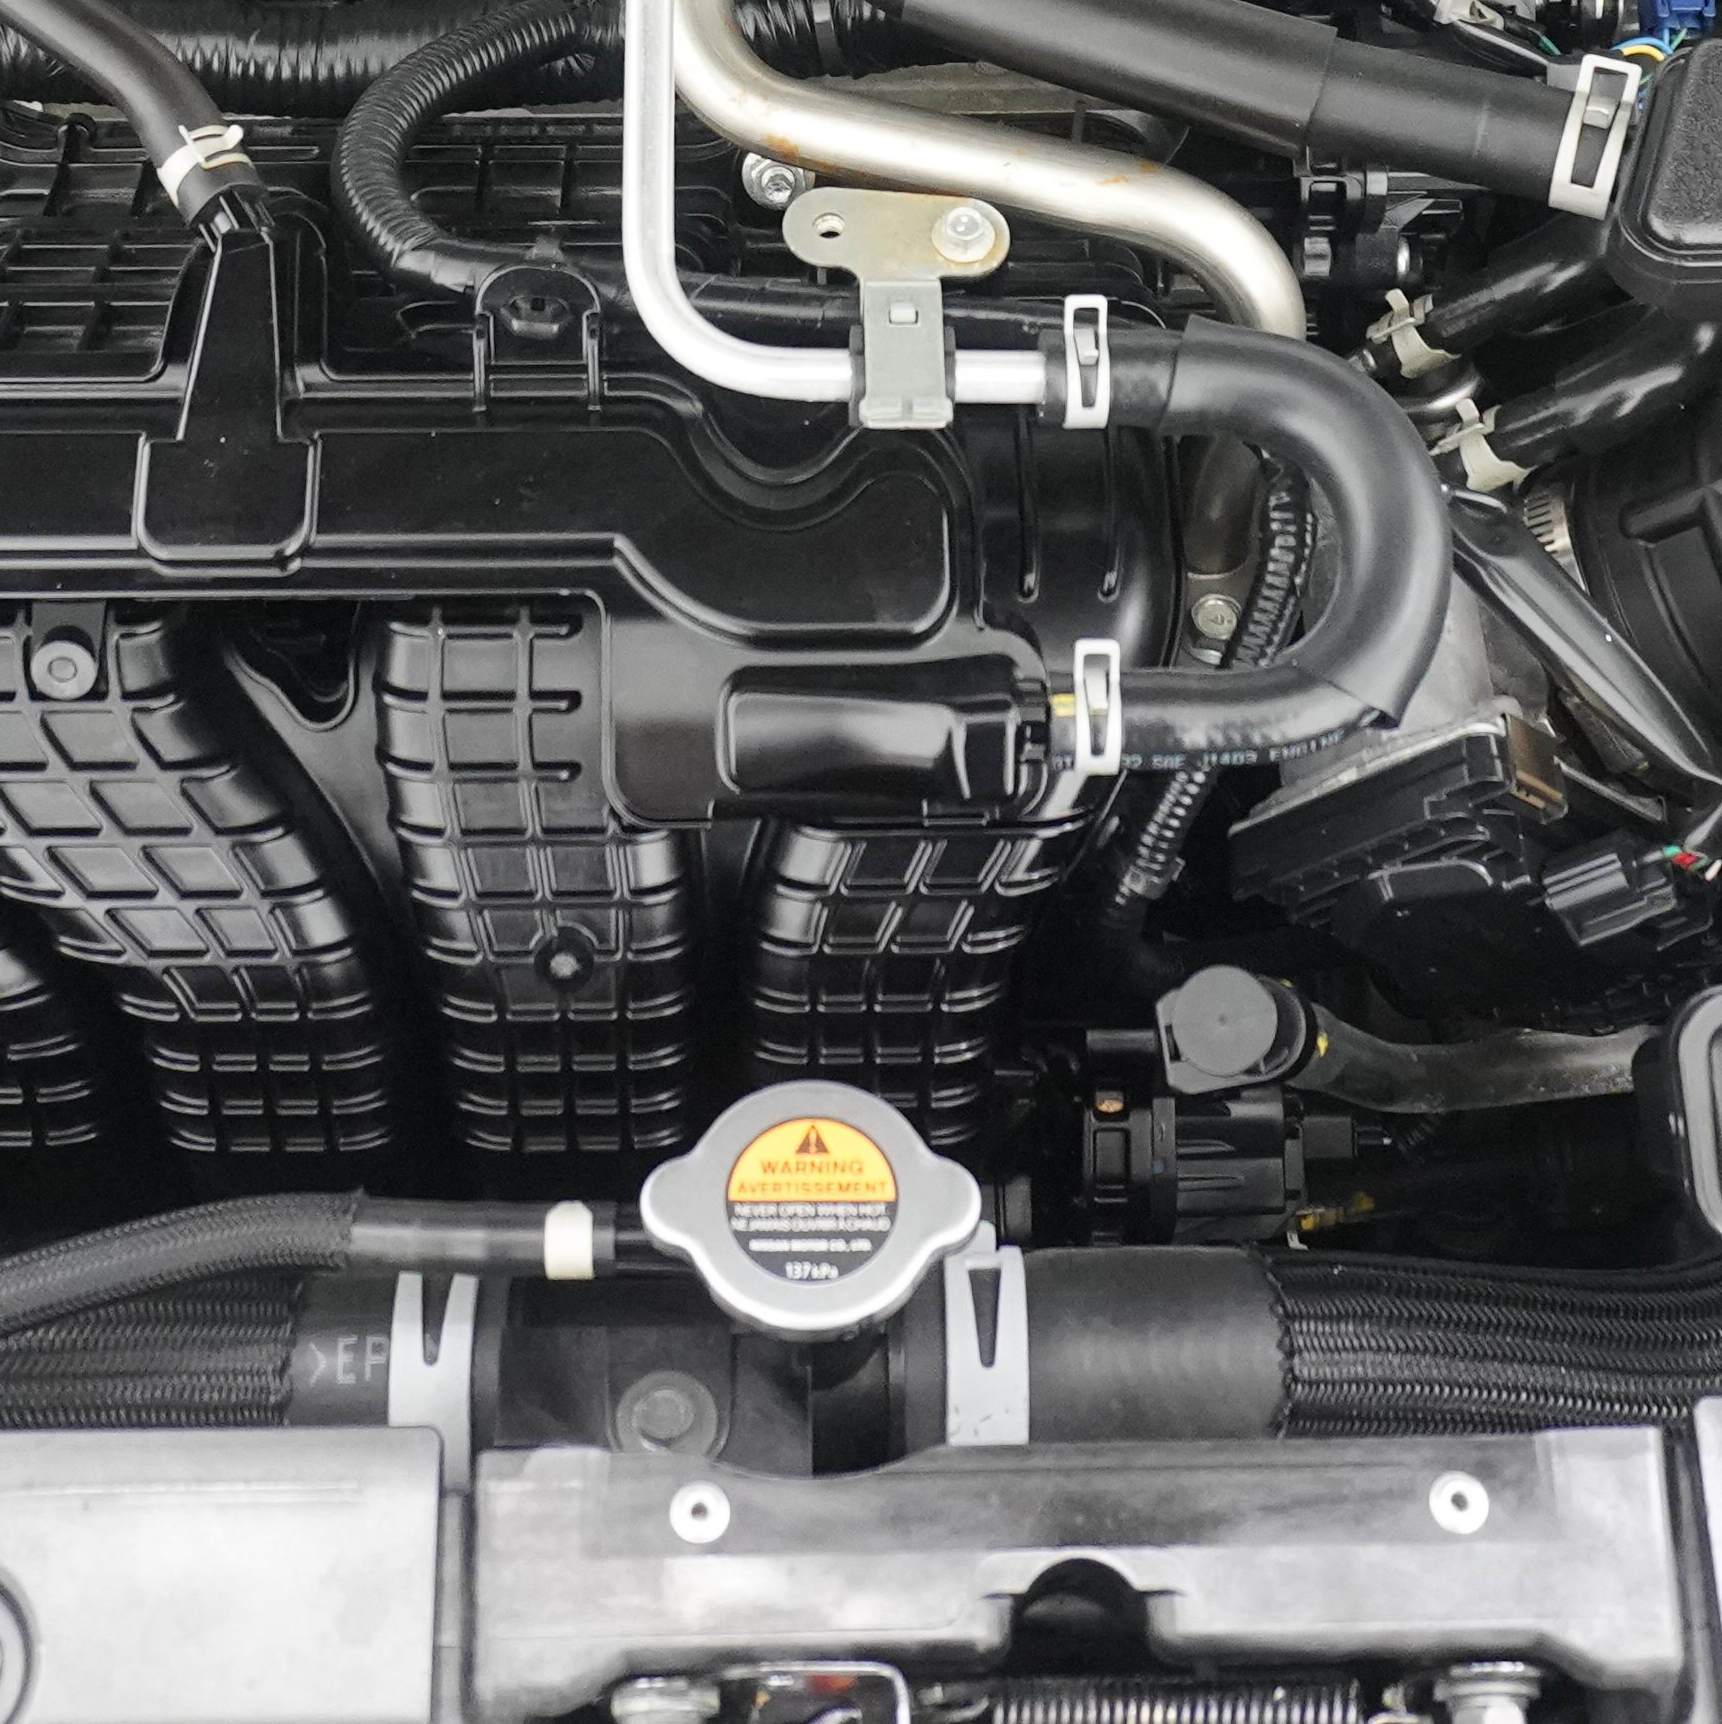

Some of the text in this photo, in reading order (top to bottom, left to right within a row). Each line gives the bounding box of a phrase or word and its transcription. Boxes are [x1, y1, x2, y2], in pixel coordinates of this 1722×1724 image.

[761, 1160, 865, 1175] WARNING
[737, 1181, 887, 1194] AVERTISSEMENT
[778, 1203, 816, 1217] OPEN
